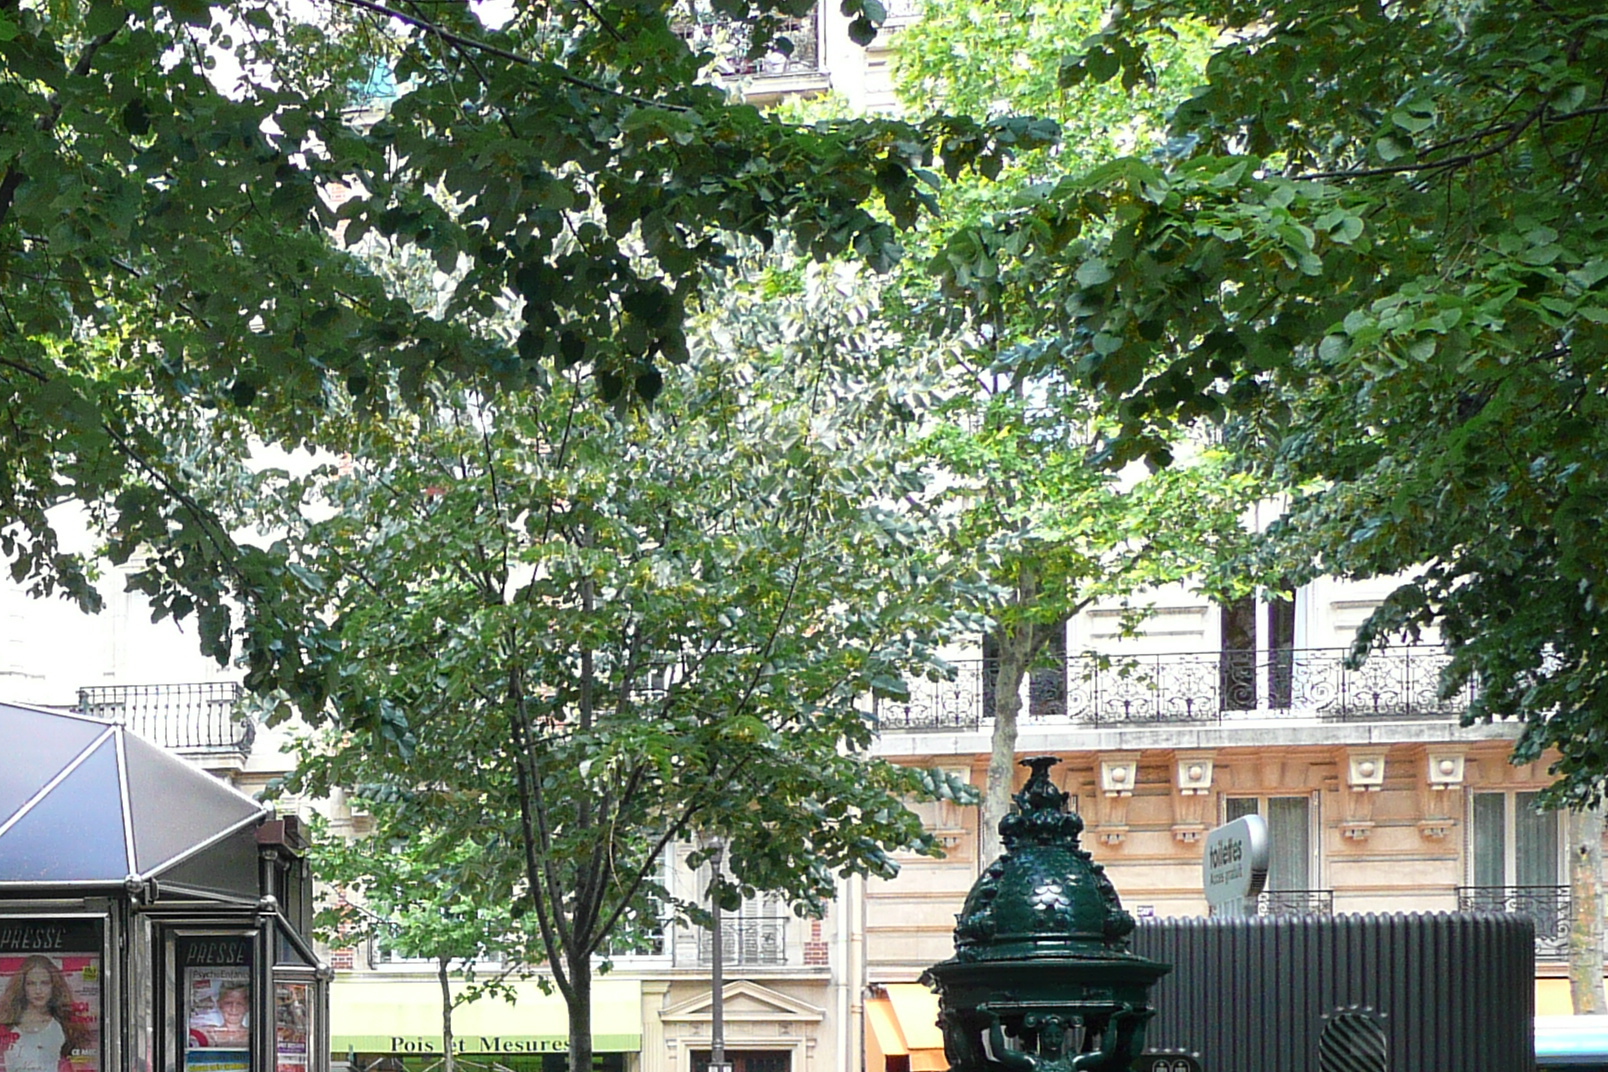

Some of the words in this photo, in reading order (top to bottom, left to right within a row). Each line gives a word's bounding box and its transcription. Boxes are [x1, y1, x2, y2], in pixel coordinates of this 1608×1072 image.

[1210, 838, 1242, 870] toilettes
[0, 927, 66, 949] PRESSE
[186, 942, 246, 964] PRESSE
[391, 1036, 434, 1052] Pois
[479, 1036, 571, 1052] Mesures
